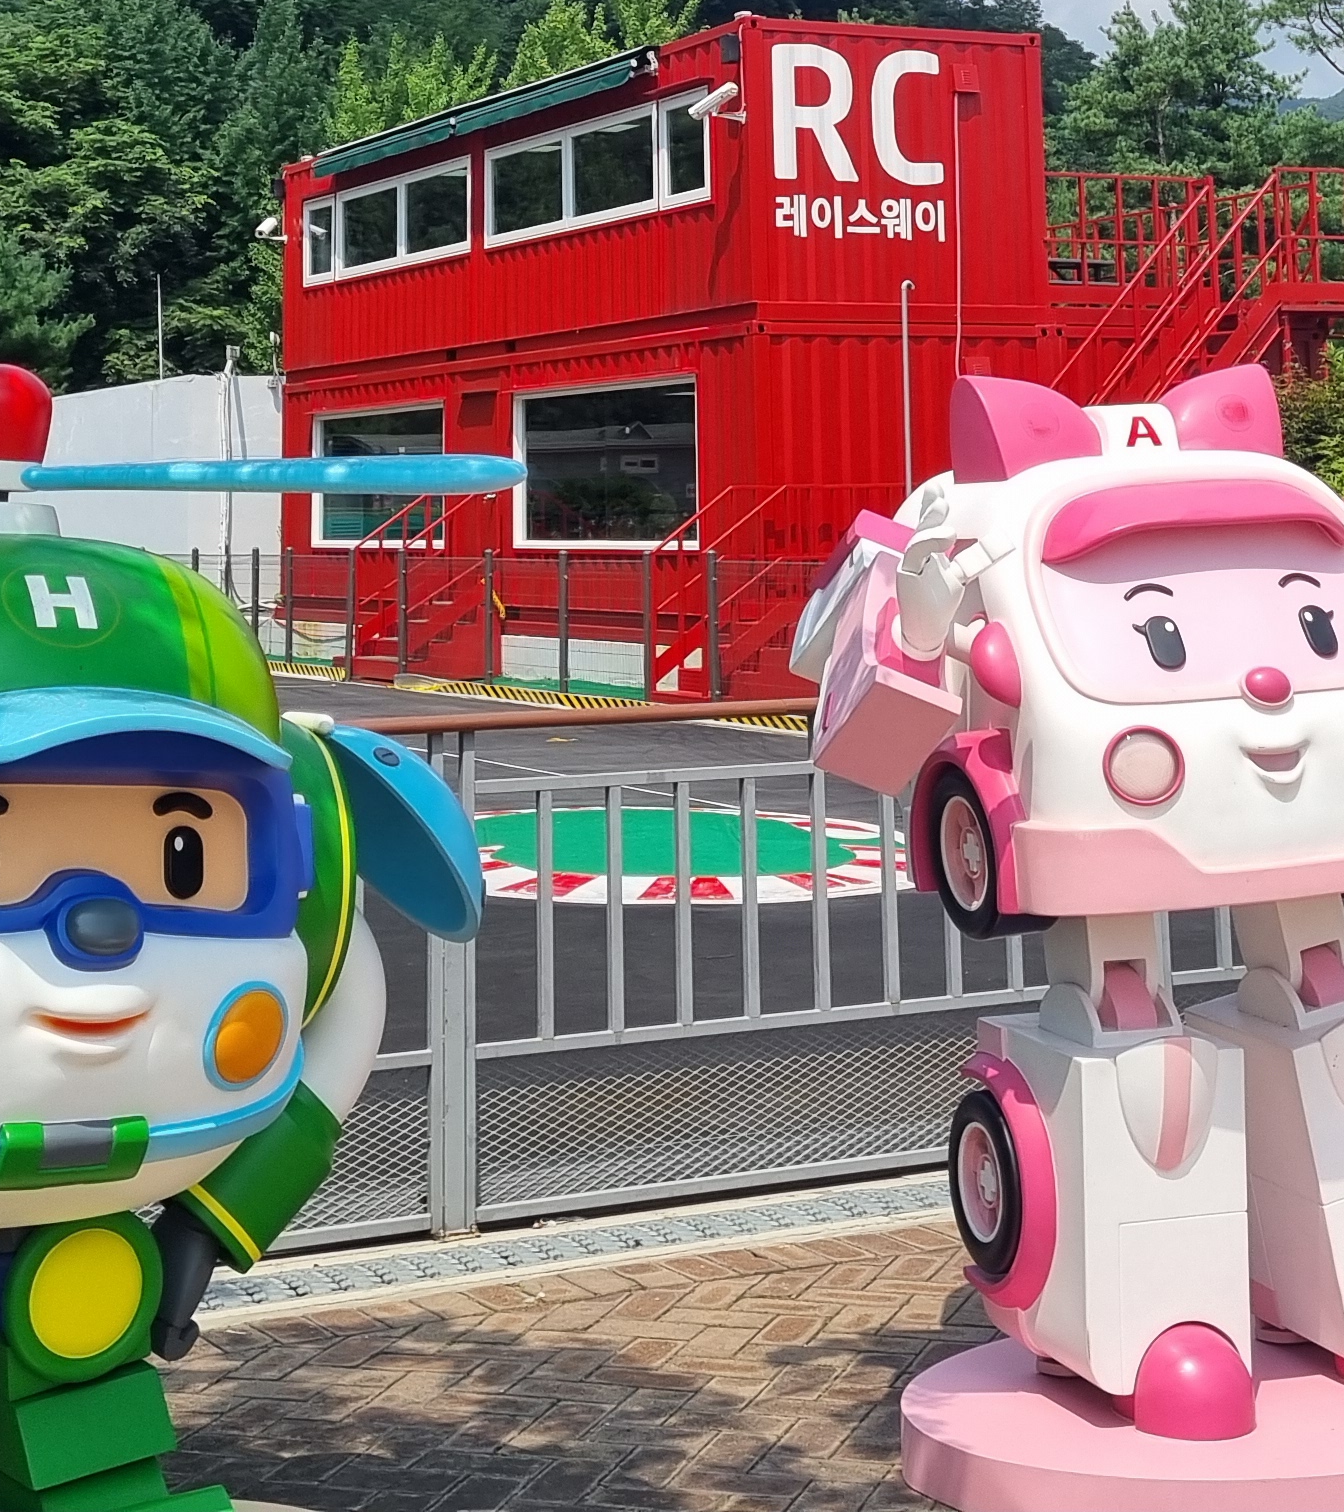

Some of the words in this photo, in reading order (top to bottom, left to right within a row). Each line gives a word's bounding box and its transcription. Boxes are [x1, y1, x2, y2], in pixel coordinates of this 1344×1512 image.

[771, 43, 944, 186] RC
[774, 194, 946, 242] 레이스웨이
[1126, 416, 1163, 447] A
[24, 574, 98, 629] H
